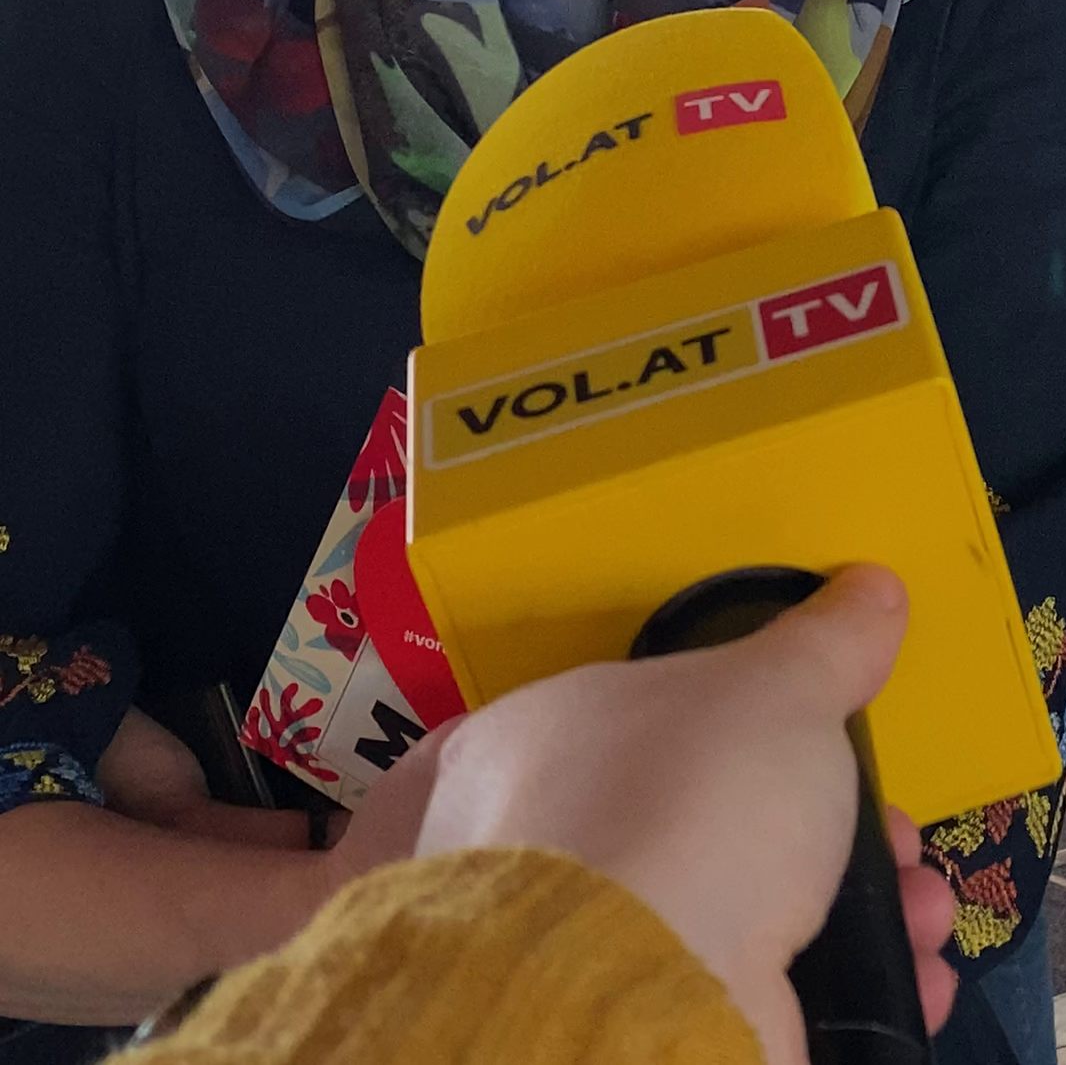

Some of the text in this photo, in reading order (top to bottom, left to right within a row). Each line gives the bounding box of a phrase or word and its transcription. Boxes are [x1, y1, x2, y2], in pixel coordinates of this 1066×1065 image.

[466, 88, 771, 236] VOL.AT TV
[456, 281, 880, 435] VOL.AT TV
[403, 629, 446, 655] #vor
